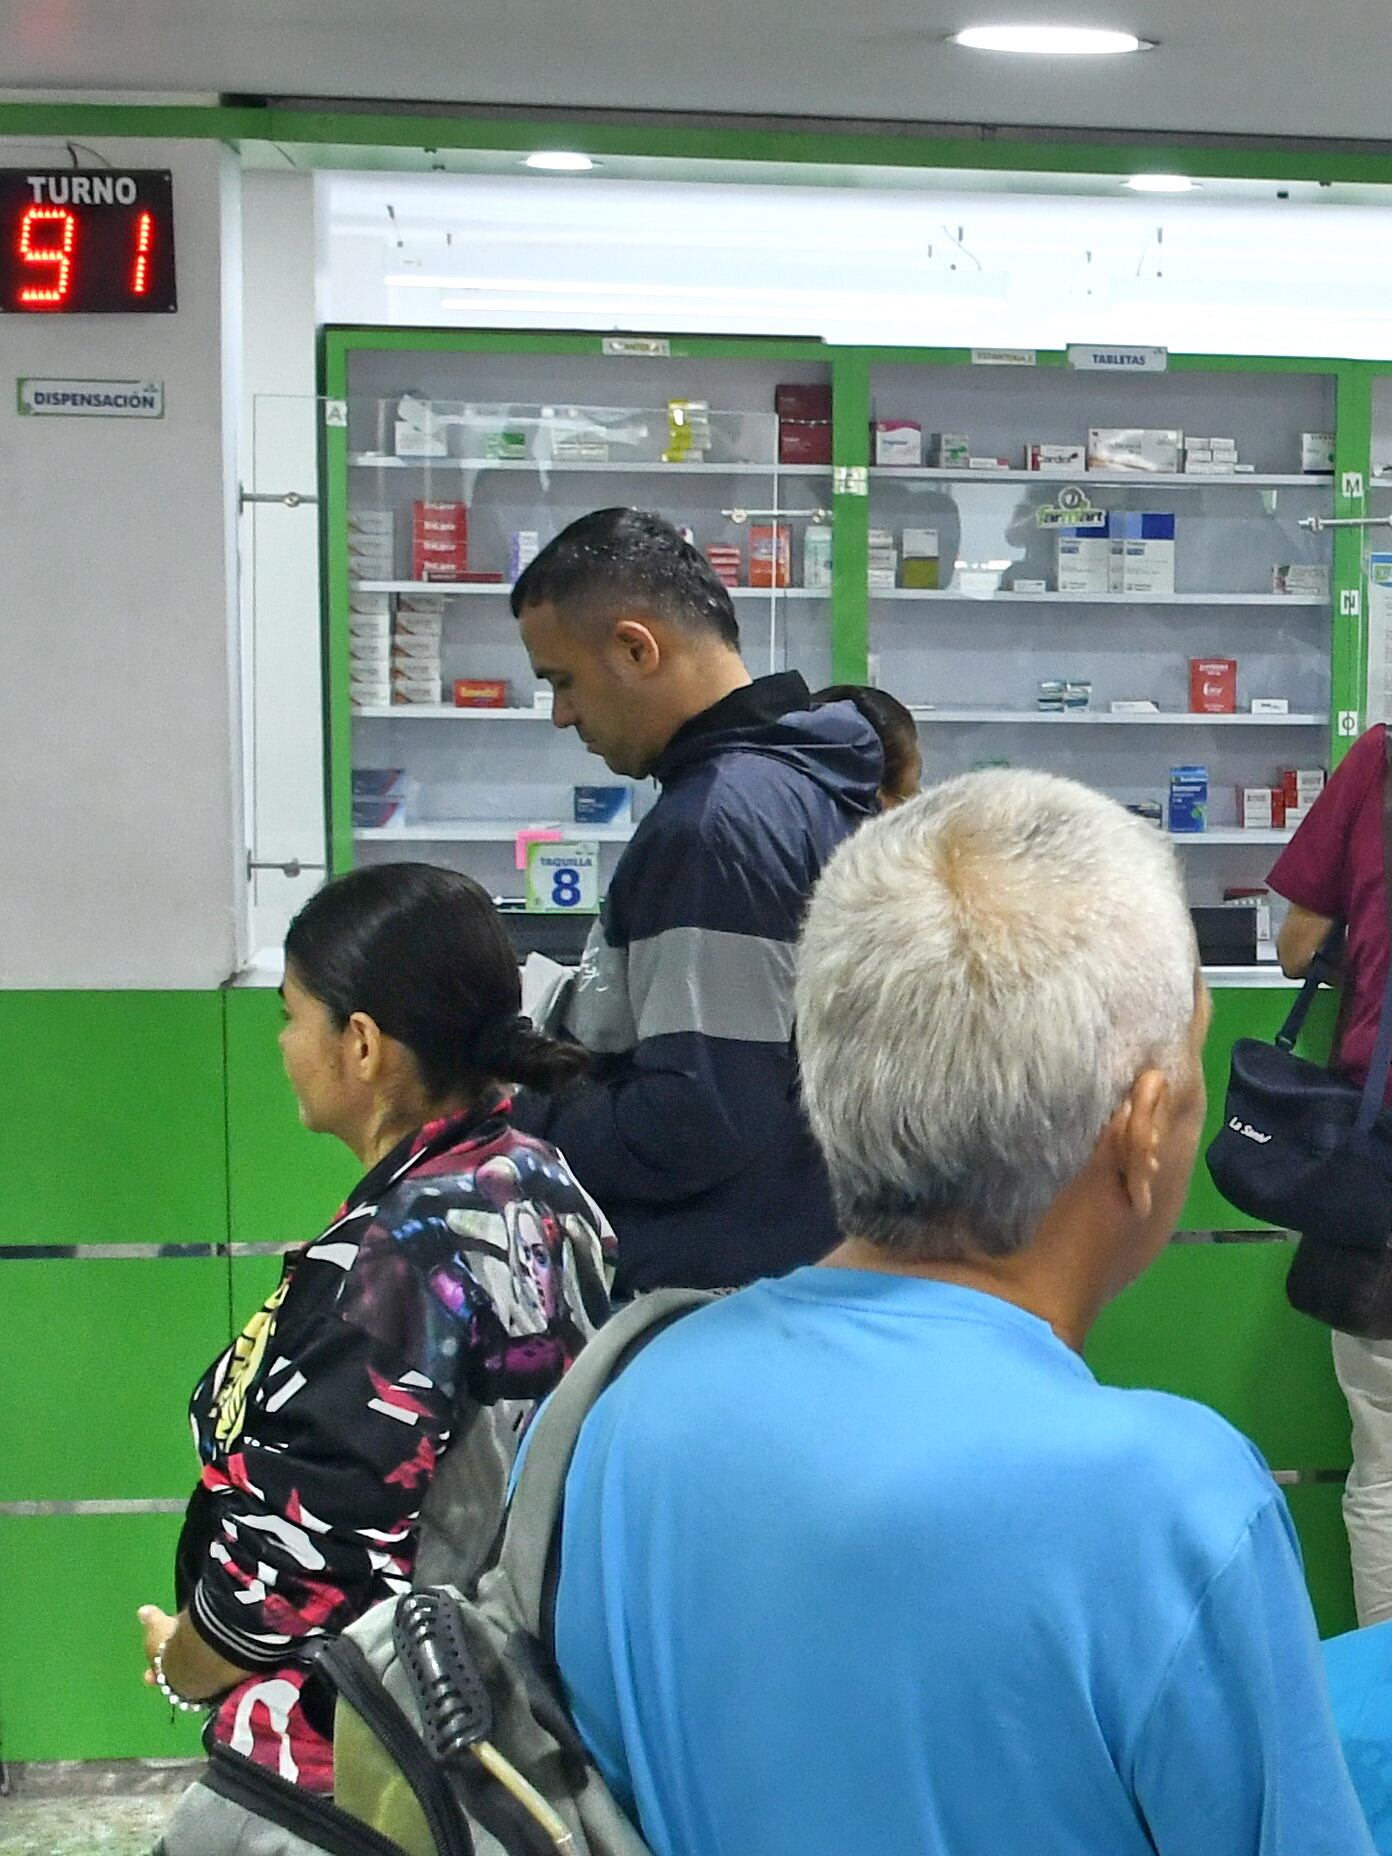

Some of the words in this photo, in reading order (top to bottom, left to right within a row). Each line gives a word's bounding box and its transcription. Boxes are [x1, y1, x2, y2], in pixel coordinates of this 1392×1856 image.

[27, 176, 138, 205] TURNO
[19, 206, 152, 303] 91
[1092, 354, 1146, 365] TABLETAS
[33, 391, 155, 410] DISPENSACIÓN
[328, 405, 342, 420] A
[1346, 479, 1360, 493] M
[1343, 595, 1355, 609] N
[541, 857, 592, 867] TAQUILLA
[552, 868, 581, 906] 8
